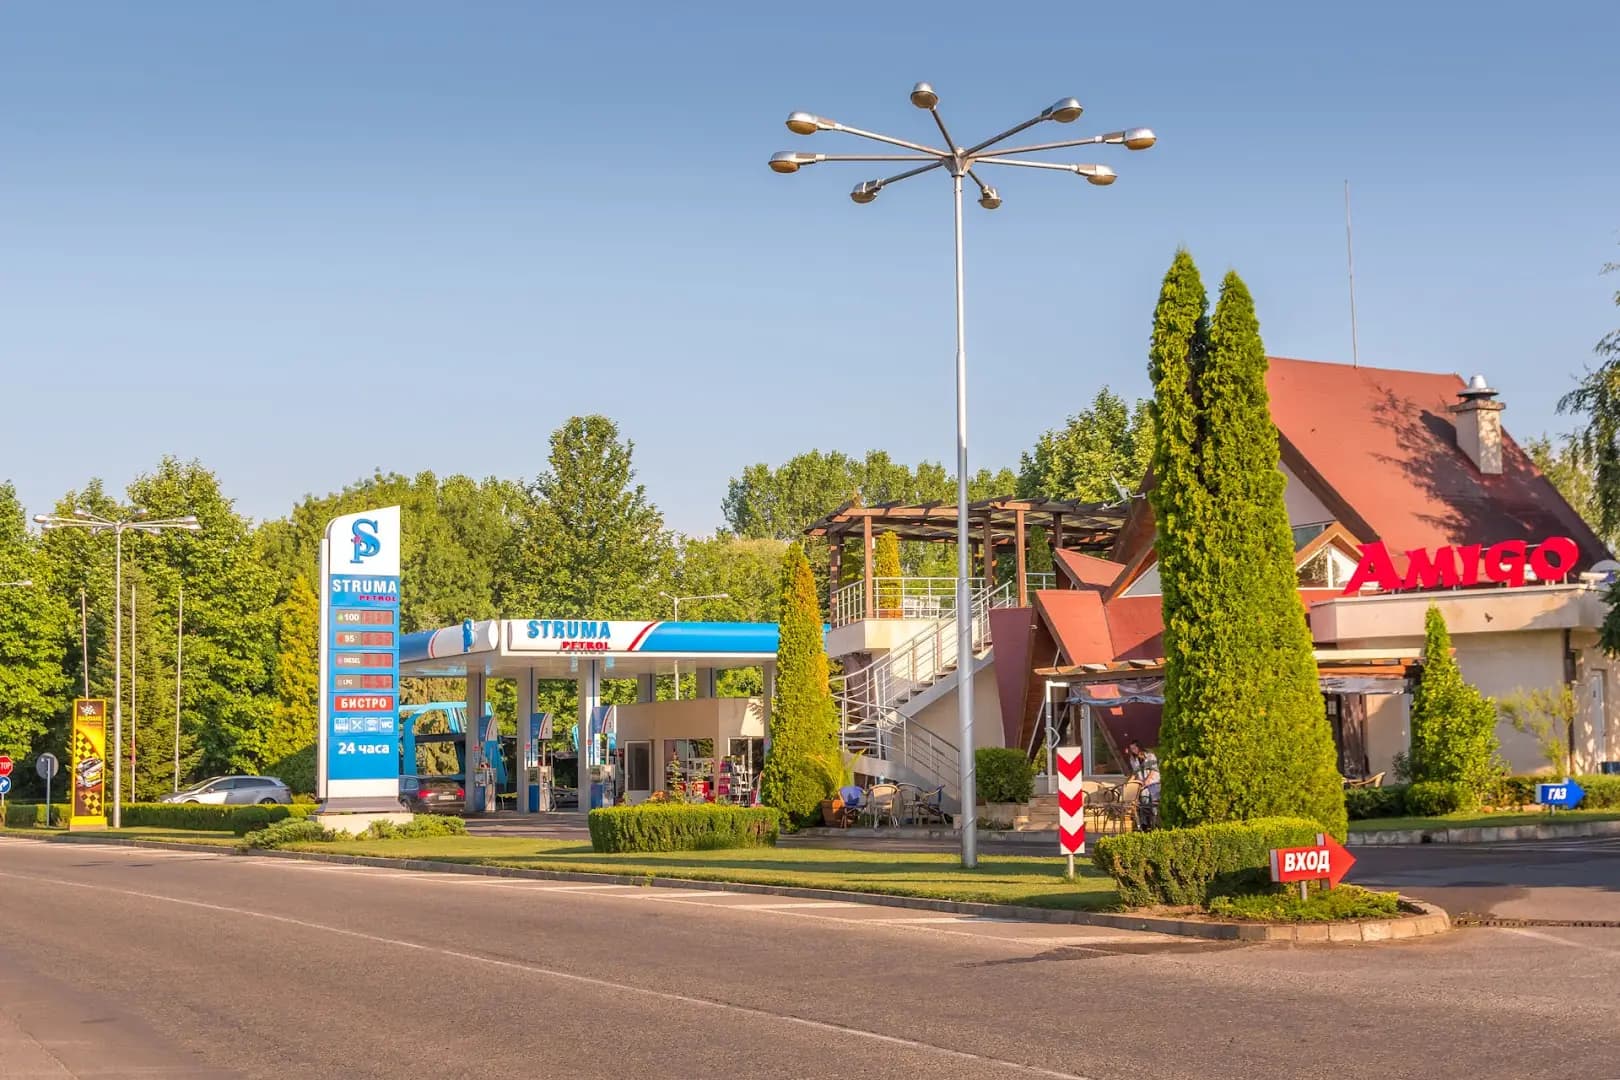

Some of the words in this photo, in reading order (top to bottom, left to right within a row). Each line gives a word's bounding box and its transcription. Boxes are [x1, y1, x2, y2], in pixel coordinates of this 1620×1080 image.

[1341, 536, 1580, 595] AMIGO
[332, 579, 397, 593] STRUMA
[344, 613, 360, 622] 100
[526, 620, 611, 639] STRUMA
[561, 640, 611, 650] PETROL
[341, 697, 387, 709] БИСТРО
[381, 721, 393, 729] WC
[338, 742, 356, 755] 24
[358, 744, 390, 754] часа
[0, 761, 11, 771] TOP
[1548, 787, 1567, 800] ГАЗ
[1284, 850, 1331, 873] ВХОД
